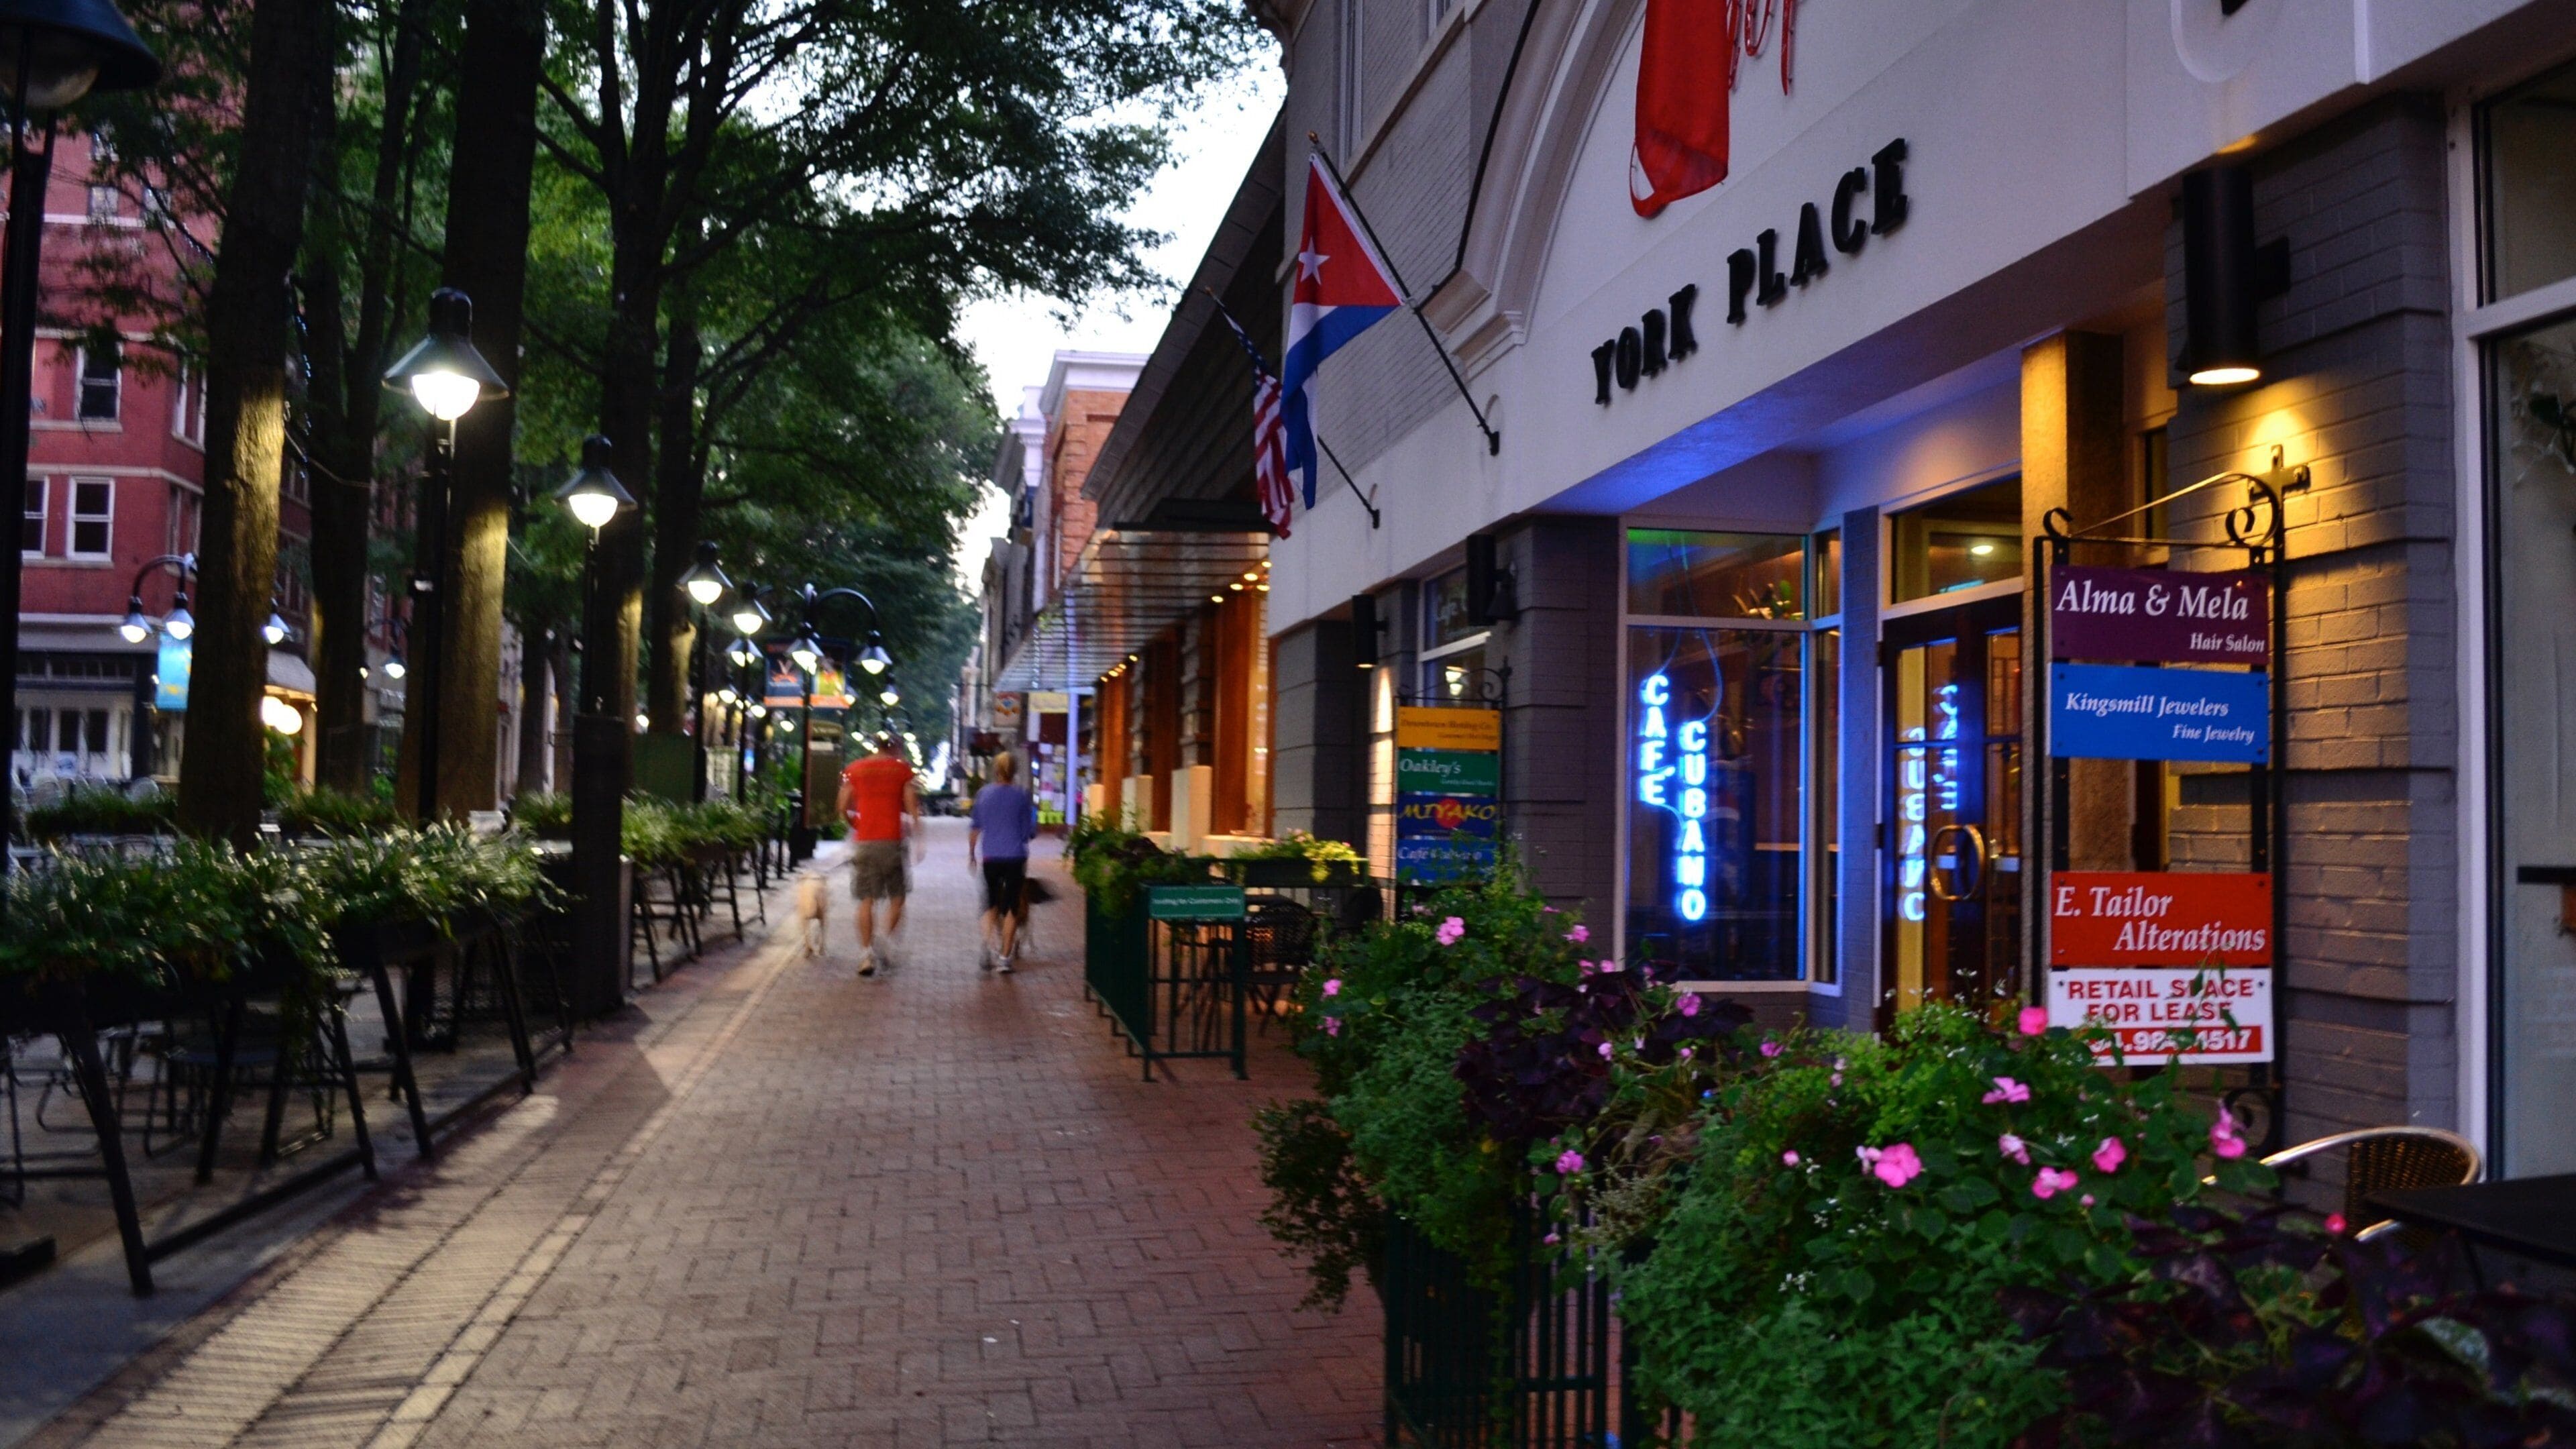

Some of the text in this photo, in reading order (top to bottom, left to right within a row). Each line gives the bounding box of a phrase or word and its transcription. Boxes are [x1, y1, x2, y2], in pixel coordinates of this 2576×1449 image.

[1591, 138, 1908, 405] YORK PLACE
[2055, 579, 2249, 621] Alma & Mela
[2190, 633, 2265, 653] Hair Salon
[2065, 692, 2229, 718] Kingsmill Jewelers
[1640, 674, 1676, 805] CAFÉ
[2172, 724, 2255, 745] Fine Jewelry
[1399, 758, 1462, 777] Oakley's
[1398, 803, 1497, 820] MIYAKO
[1678, 720, 1707, 921] CUBANO
[2055, 885, 2173, 918] E. Tailor
[2112, 920, 2265, 952] Alterations
[2068, 979, 2159, 1000] RETAIL
[2087, 1003, 2139, 1022] FOR
